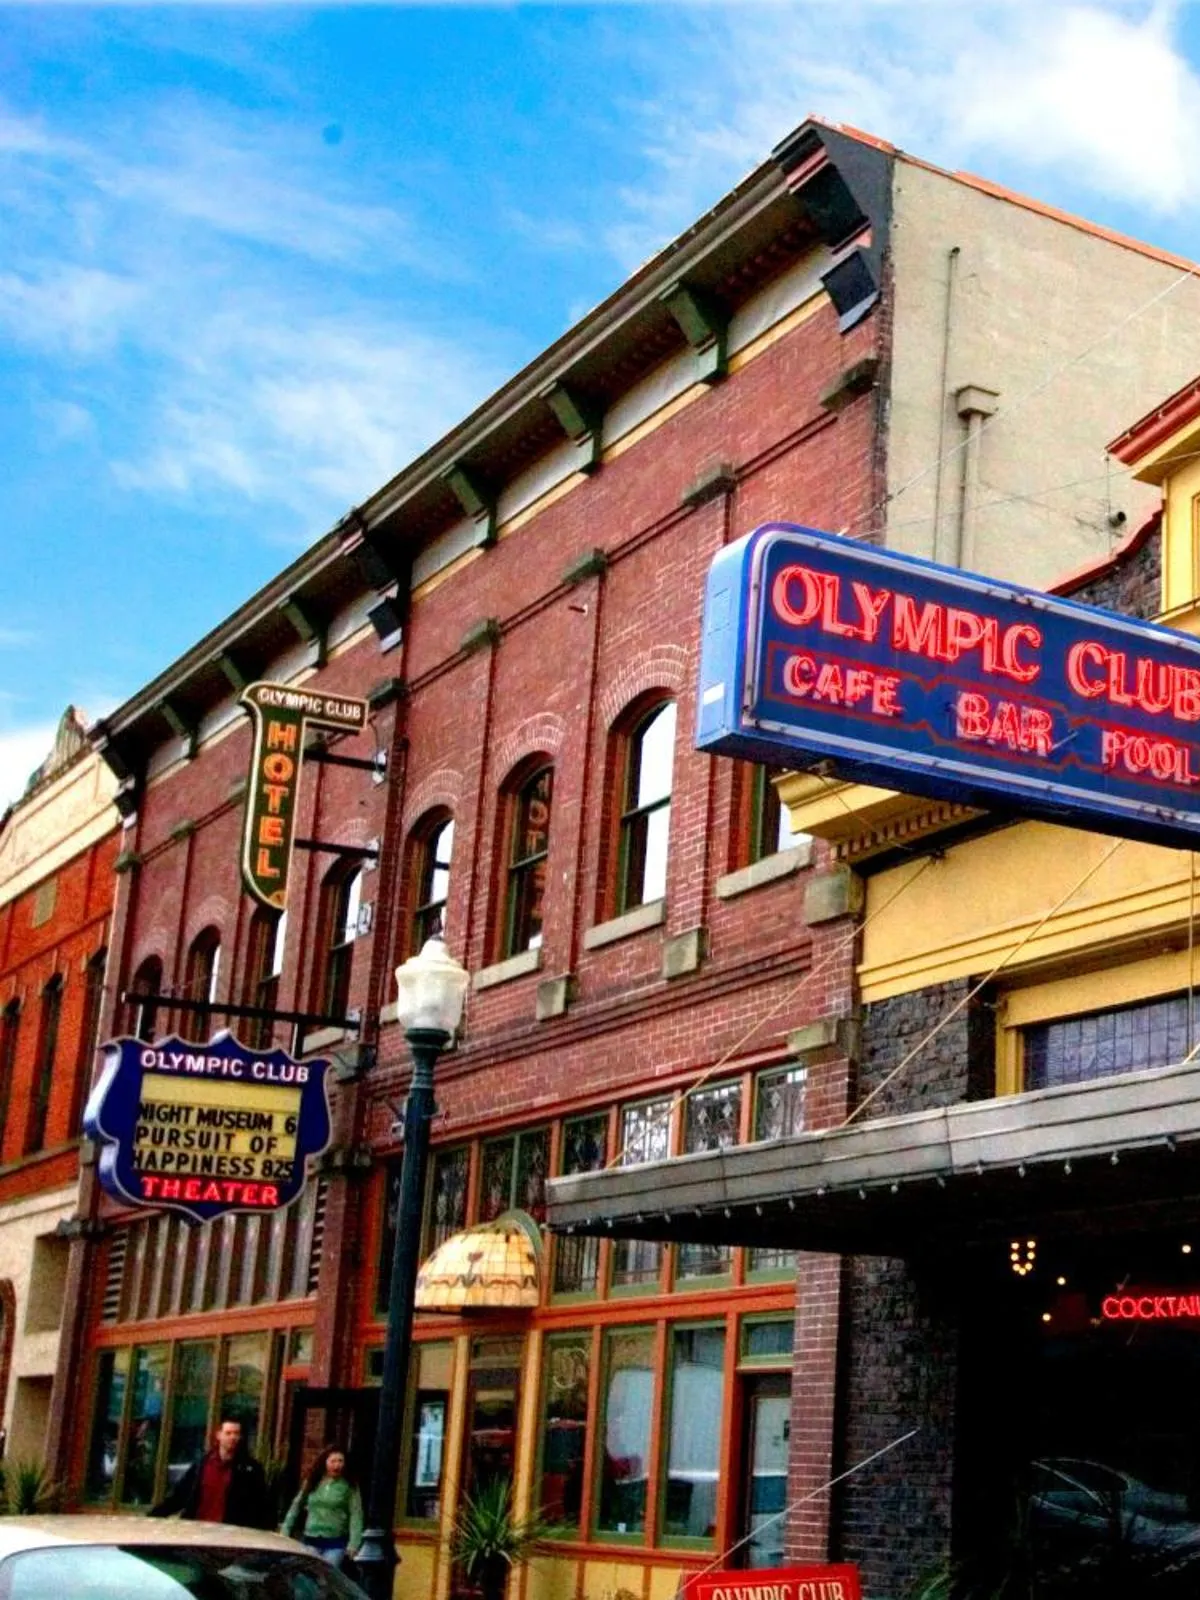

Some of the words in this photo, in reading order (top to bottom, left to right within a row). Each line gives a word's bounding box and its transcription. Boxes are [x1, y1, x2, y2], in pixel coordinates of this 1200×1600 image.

[772, 564, 1041, 683] OLYMPIC
[259, 688, 321, 712] OLYMPIC
[325, 700, 361, 719] CLUB
[783, 655, 903, 716] CAFE
[956, 691, 1053, 756] BAR
[1102, 729, 1199, 785] POOL
[257, 721, 296, 877] HOTEL
[140, 1050, 244, 1076] OLYMPIC
[252, 1061, 309, 1082] CLUB
[138, 1103, 193, 1126] NIGHT
[196, 1109, 273, 1131] MUSEUM
[135, 1126, 236, 1151] PURSUIT
[250, 1136, 278, 1154] OF
[133, 1151, 254, 1176] HAPPINESS
[142, 1178, 278, 1205] THEATER
